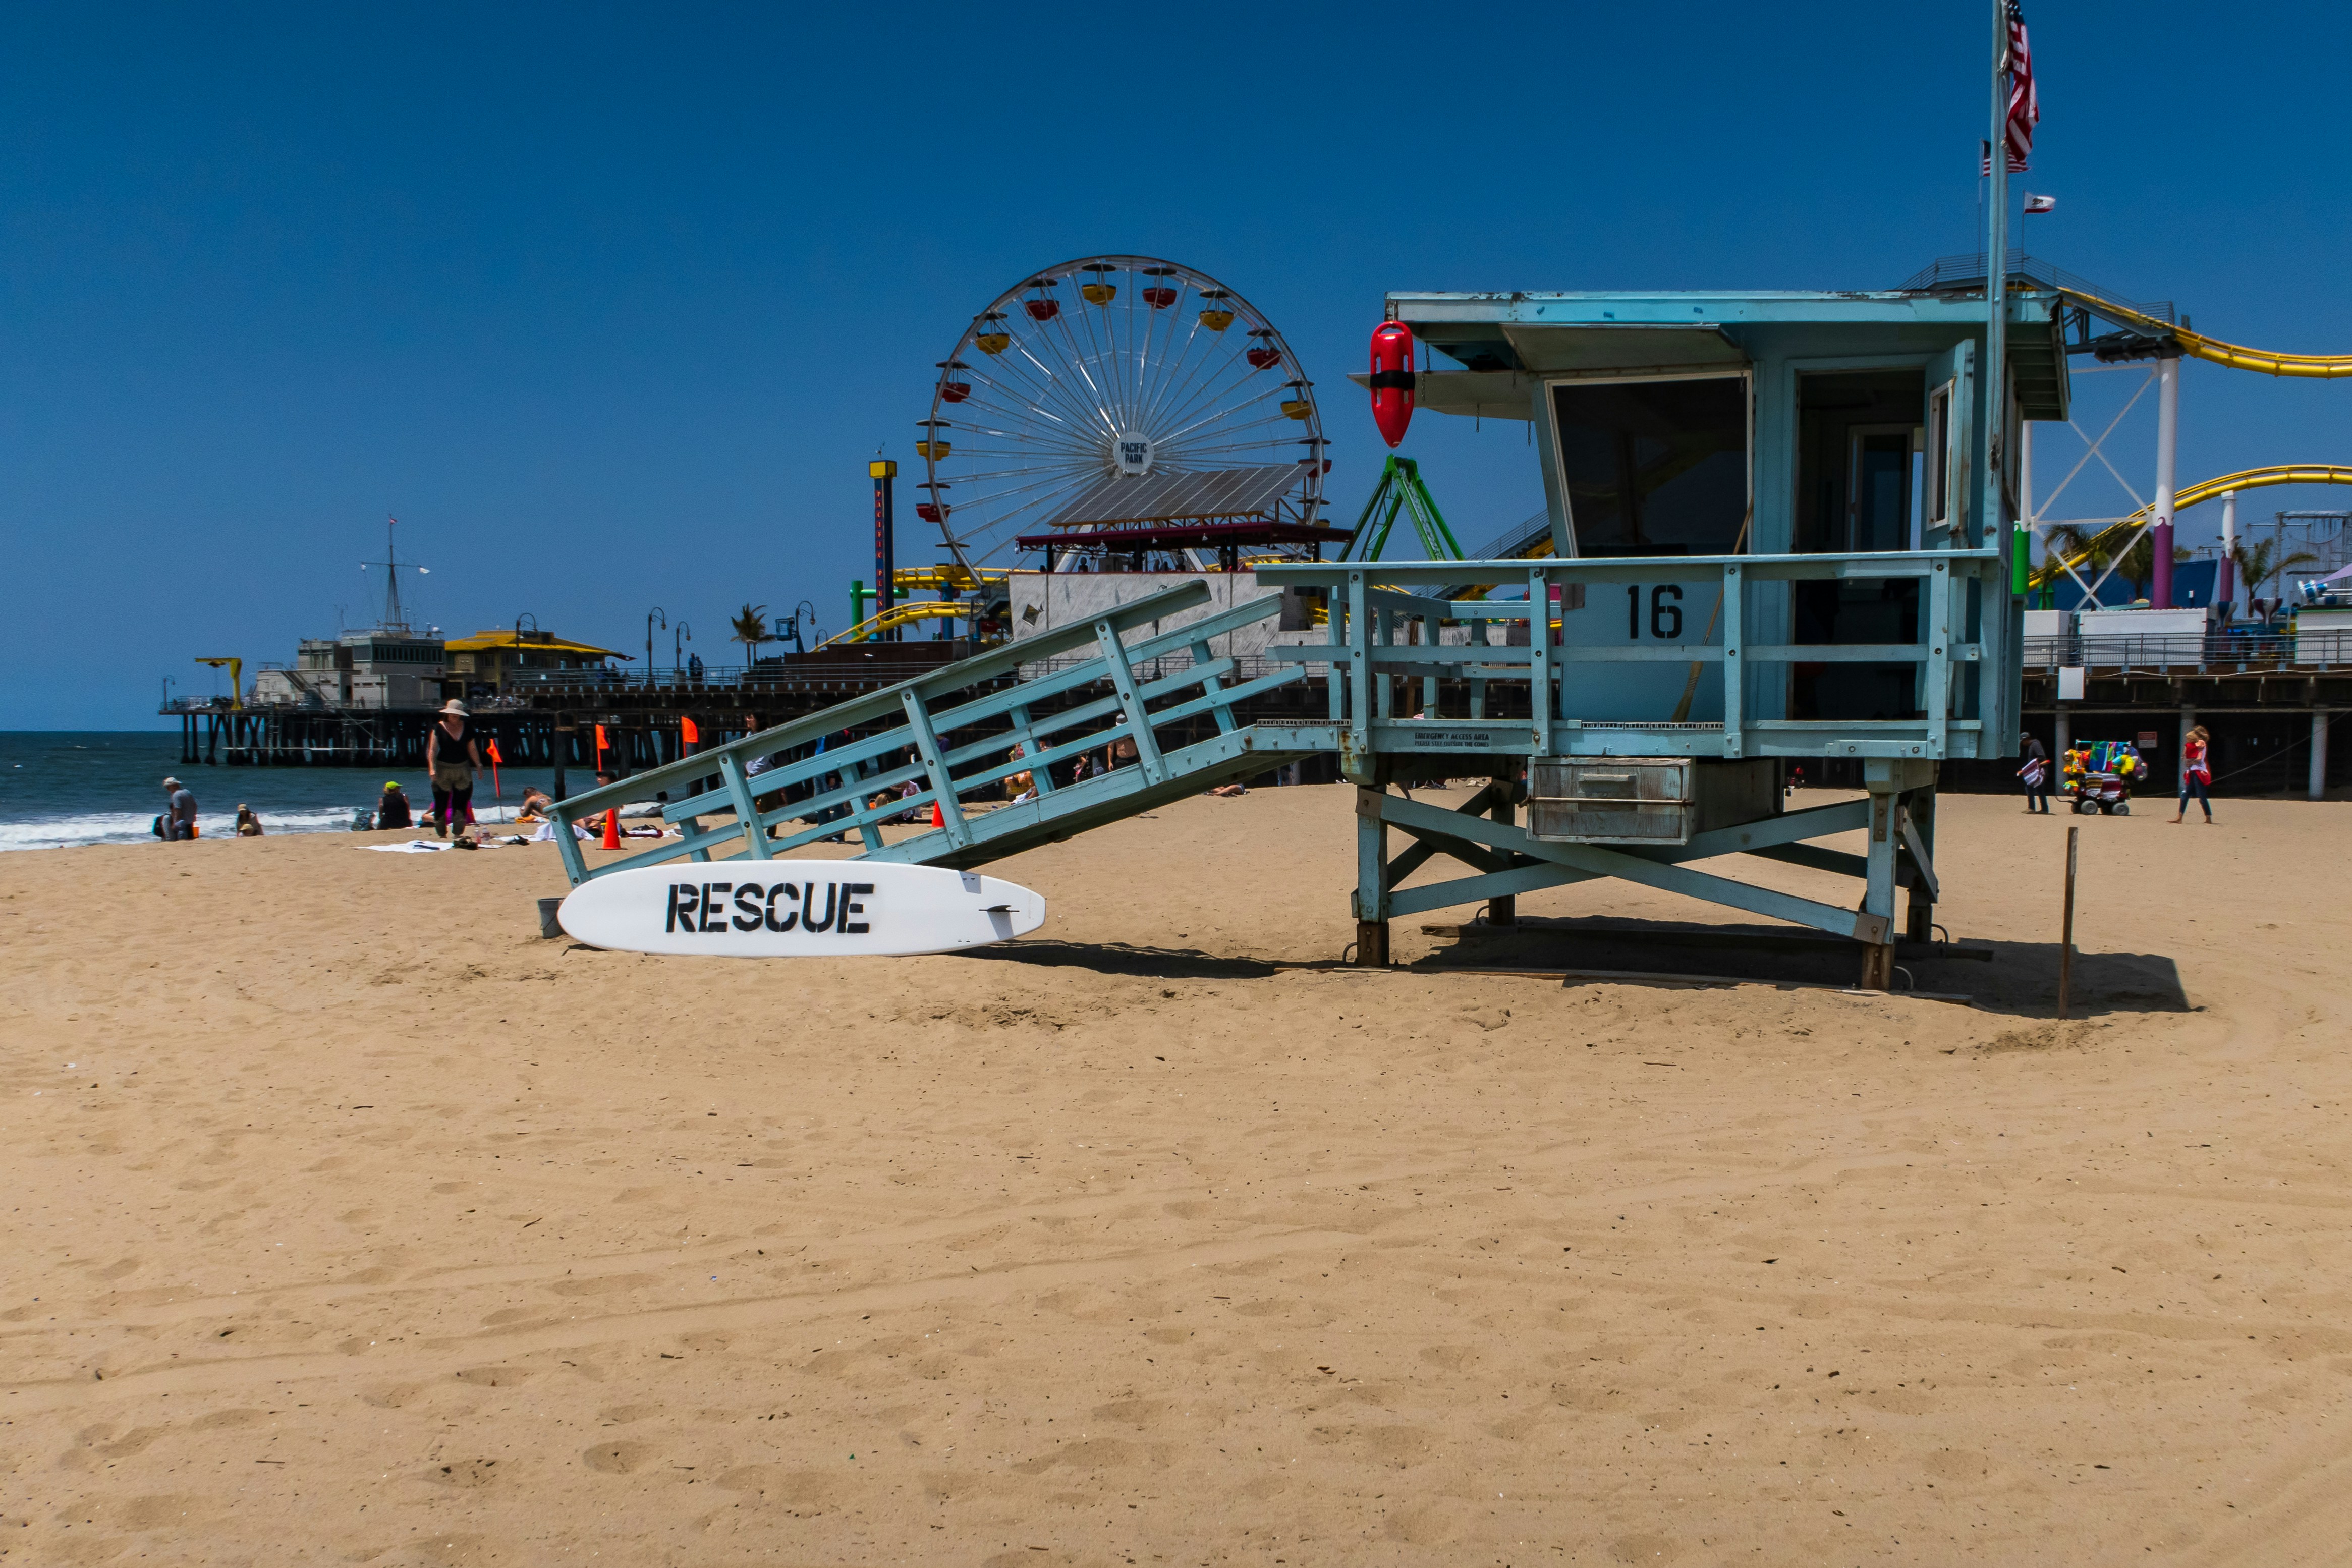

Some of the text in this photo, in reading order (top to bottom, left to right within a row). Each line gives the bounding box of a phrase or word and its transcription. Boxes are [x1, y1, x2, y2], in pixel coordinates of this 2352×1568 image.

[1121, 442, 1147, 453] PACIFIC
[1125, 453, 1143, 464] PARK
[1627, 584, 1683, 639] 16
[665, 882, 875, 934] RESCUE
